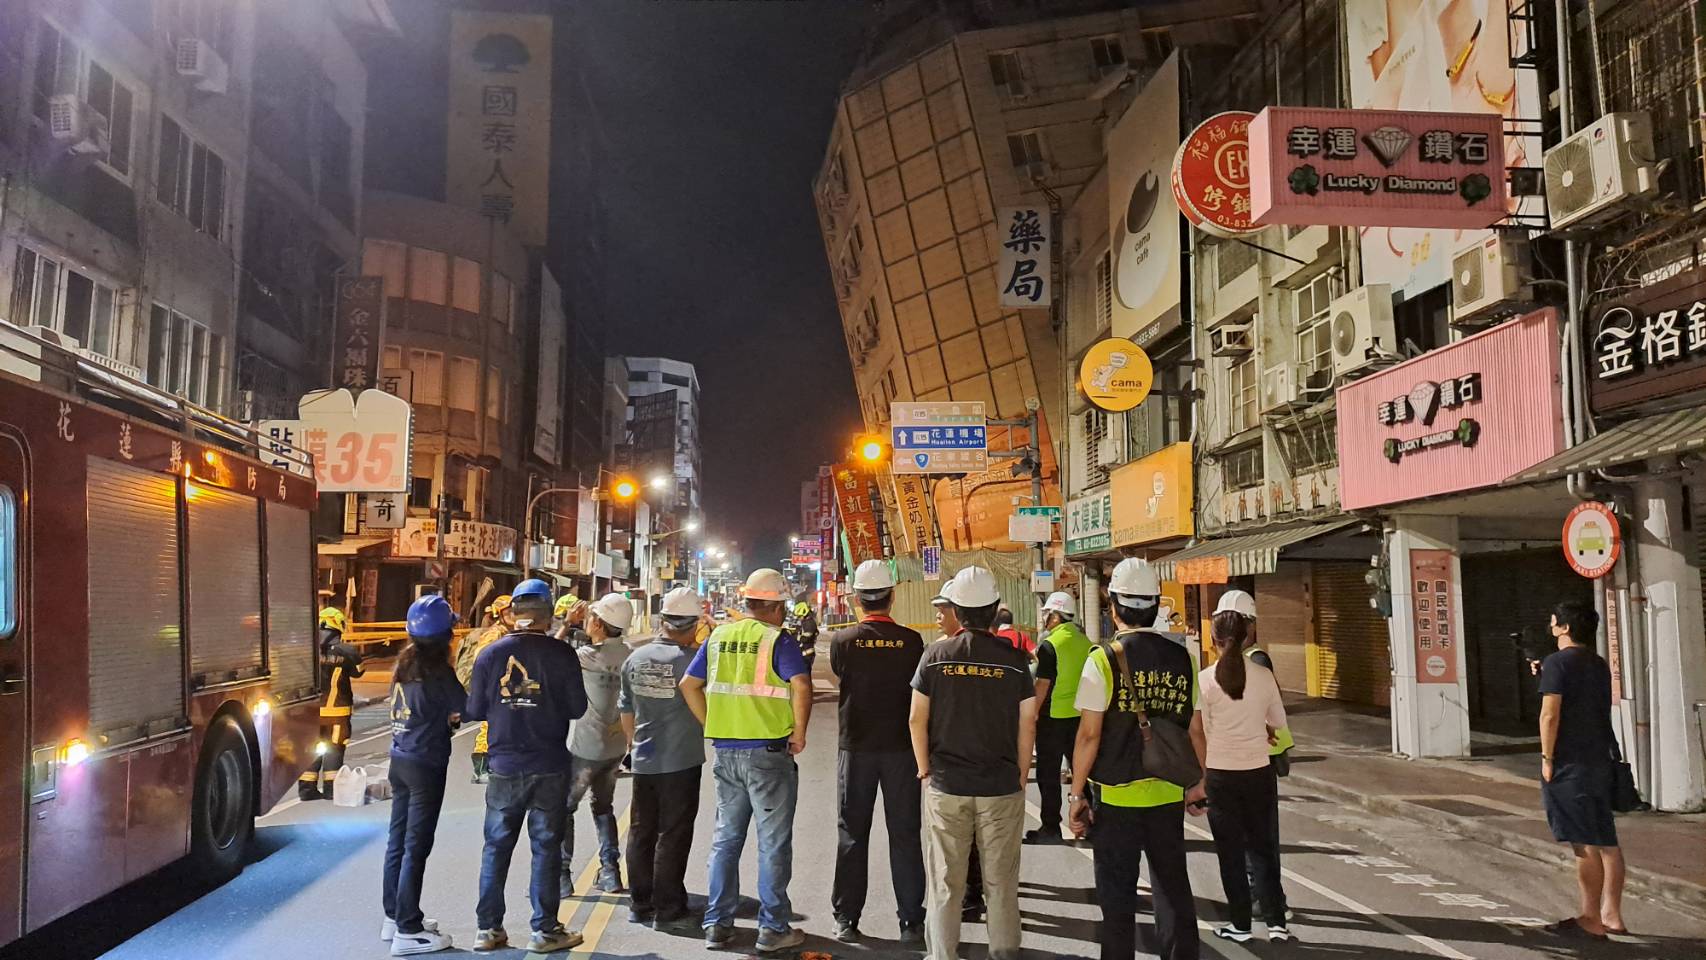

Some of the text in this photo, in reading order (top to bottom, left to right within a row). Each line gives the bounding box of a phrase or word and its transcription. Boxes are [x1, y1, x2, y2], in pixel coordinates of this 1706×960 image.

[481, 84, 515, 225] 國泰人壽
[1289, 126, 1489, 162] 幸運 鑽石
[1326, 174, 1456, 191] Lucky Diamond
[1003, 210, 1046, 302] 藥局
[344, 307, 369, 391] 金六福珠
[1111, 379, 1143, 388] cama
[1378, 374, 1474, 423] 幸運 鑽石
[931, 428, 984, 439] 花蓮機場
[959, 439, 984, 447] Airport
[1397, 430, 1455, 453] LUCKY DIAMOND
[56, 401, 287, 501] 花蓮縣防局
[330, 431, 398, 485] 35
[918, 454, 926, 463] 9
[374, 498, 396, 522] 奇
